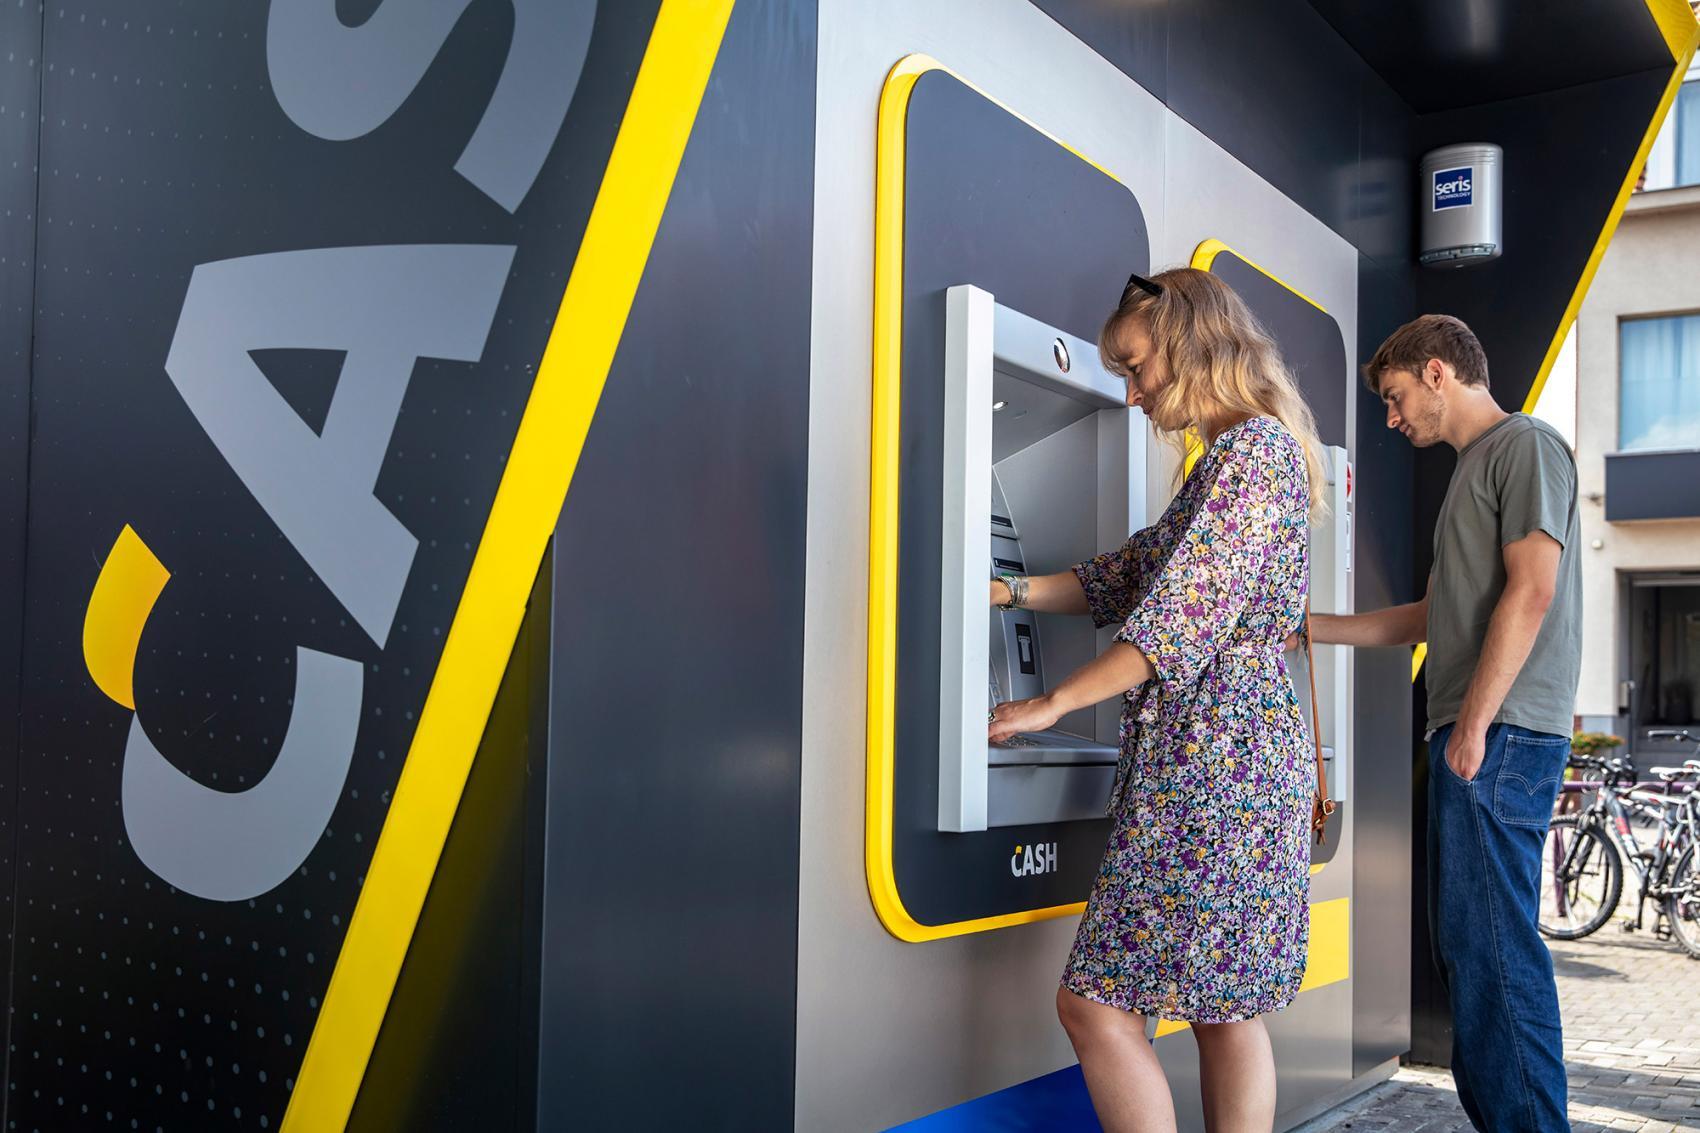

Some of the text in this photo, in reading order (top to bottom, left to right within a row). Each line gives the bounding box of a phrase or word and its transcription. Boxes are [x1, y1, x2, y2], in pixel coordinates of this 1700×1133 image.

[1435, 175, 1471, 196] seris
[1437, 192, 1471, 201] TECHNOLOGY
[1011, 842, 1057, 877] CASH
